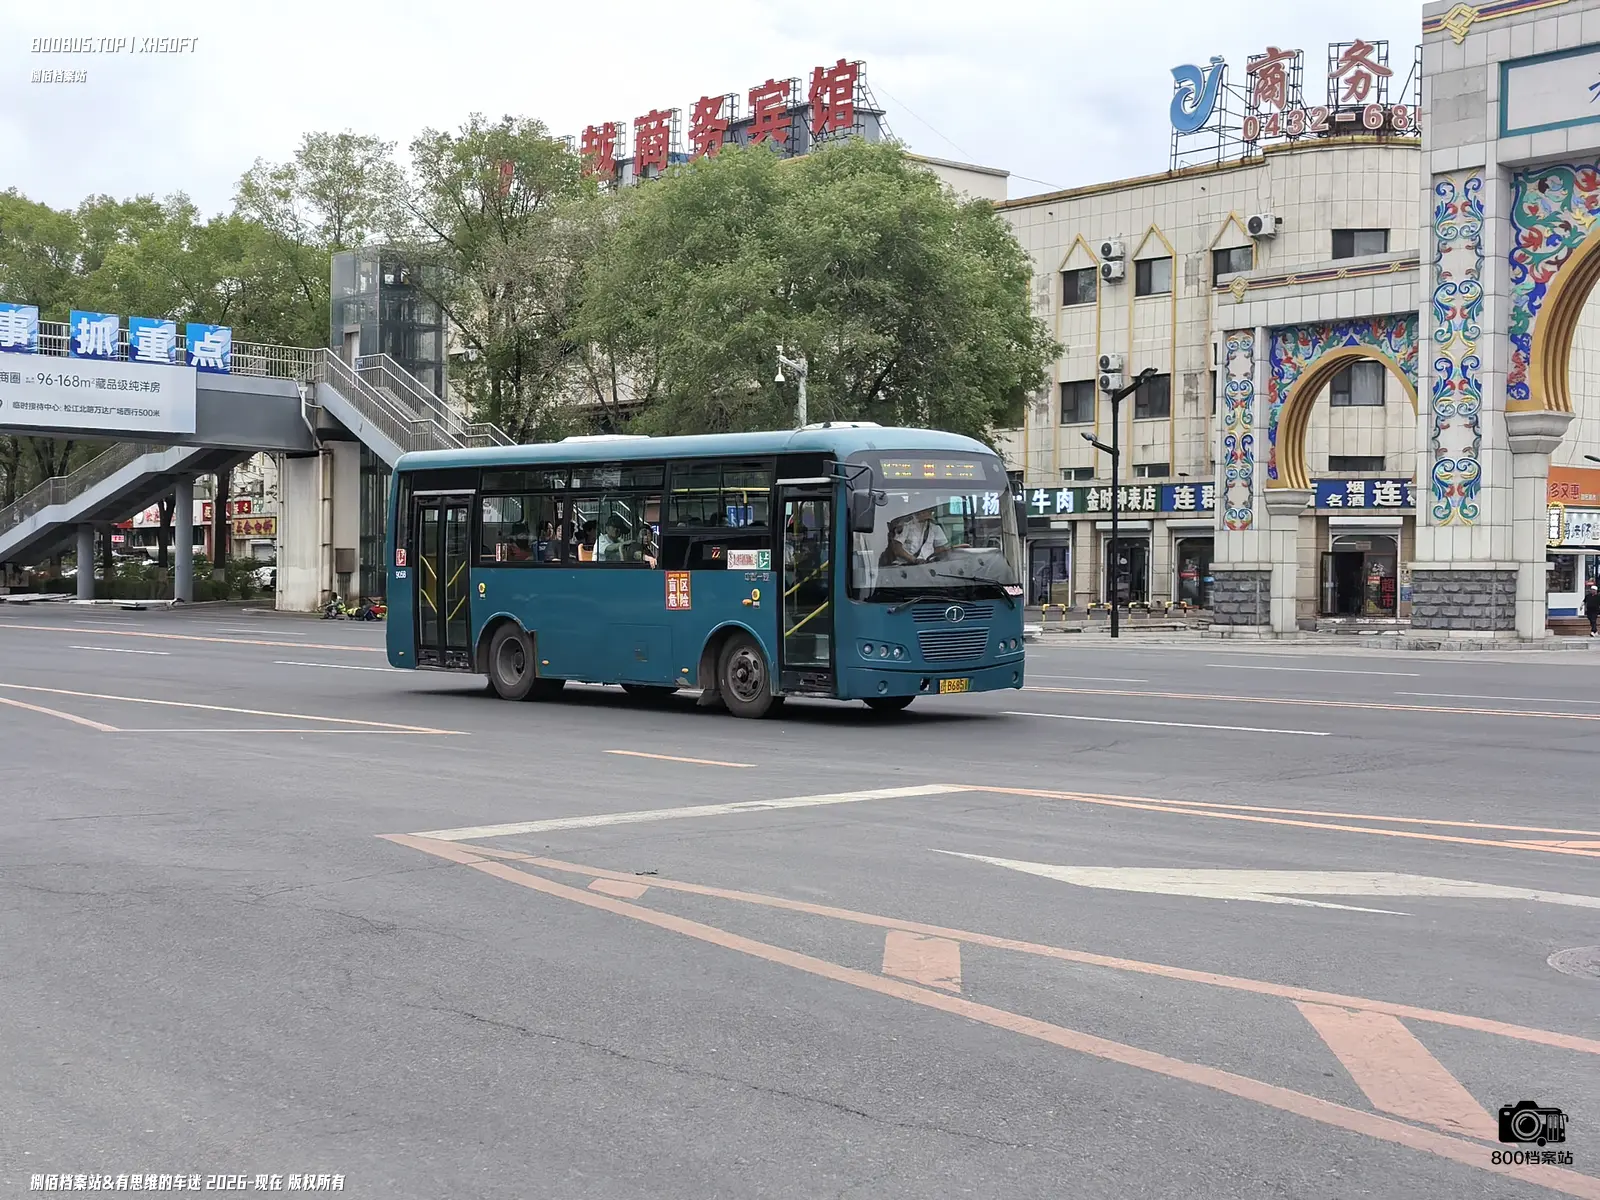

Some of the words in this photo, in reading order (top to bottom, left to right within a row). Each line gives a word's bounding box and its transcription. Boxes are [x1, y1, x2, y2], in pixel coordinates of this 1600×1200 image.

[1246, 39, 1393, 110] 商务
[0, 309, 224, 369] 事抓重点
[0, 372, 21, 384] 商圈
[1086, 485, 1157, 512] 金时钟表店
[667, 593, 690, 608] 危险
